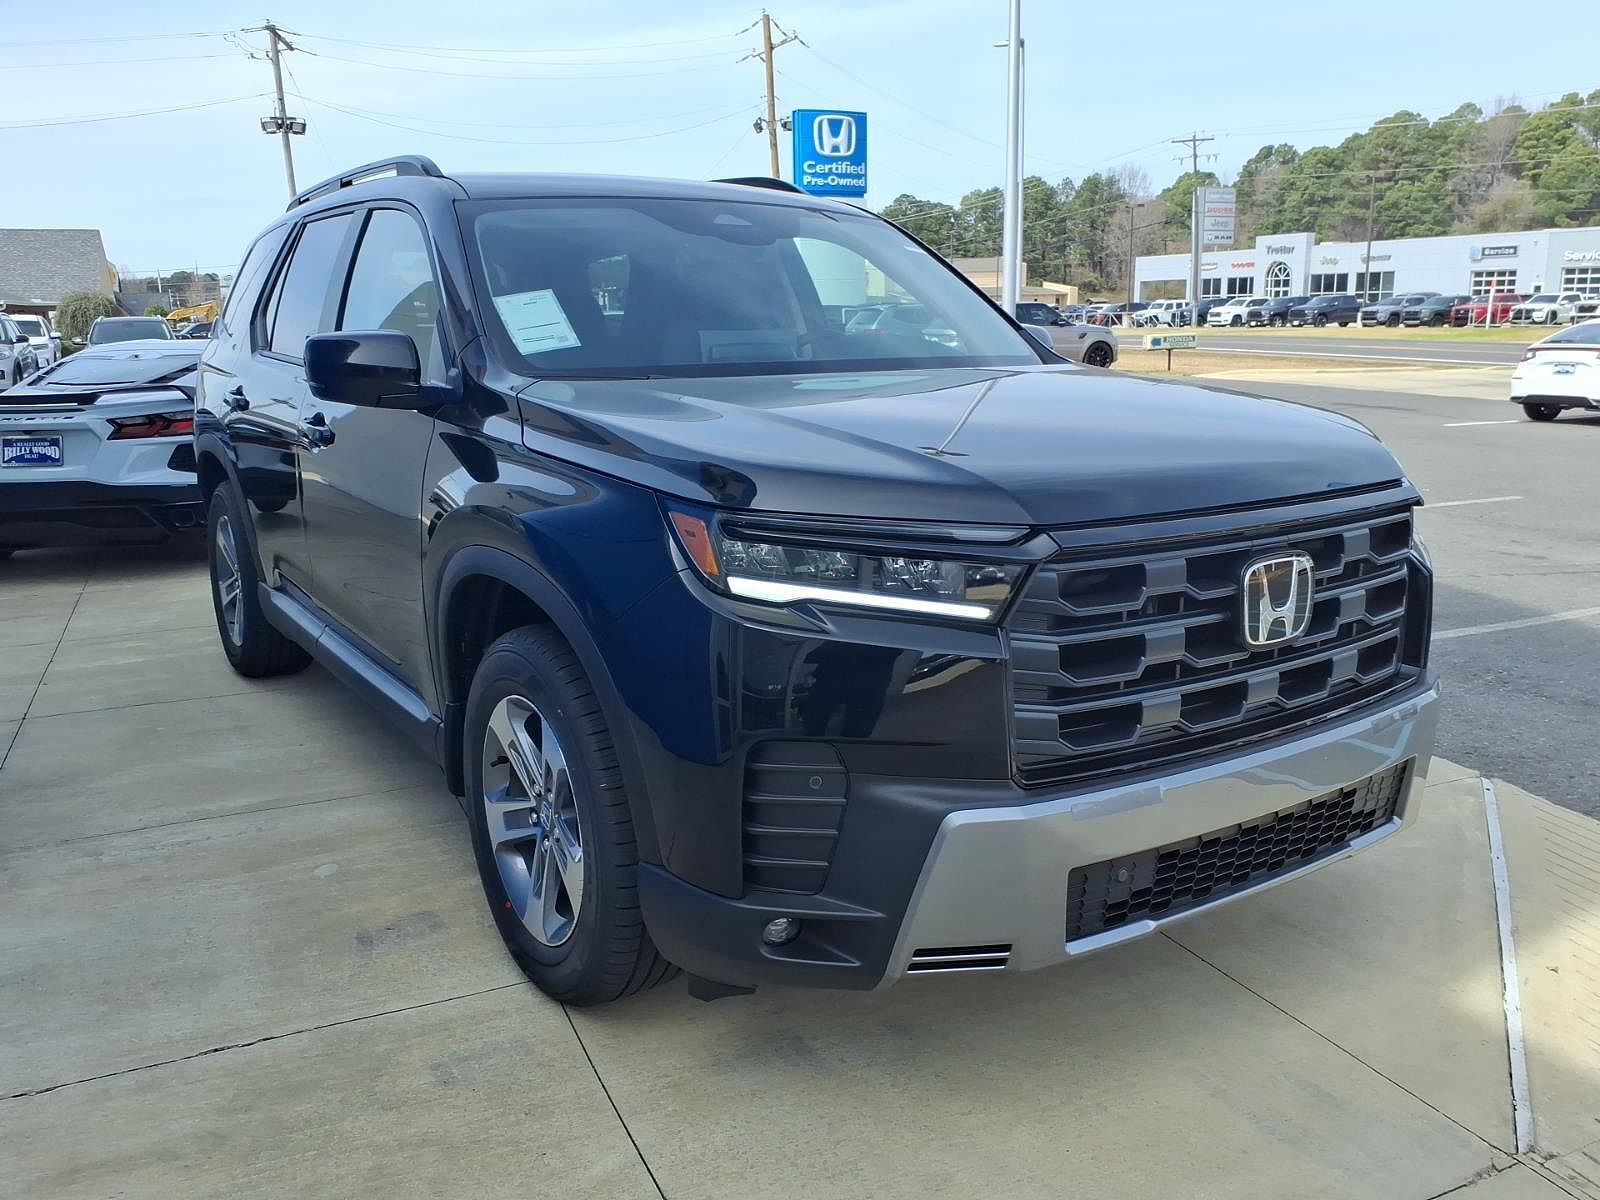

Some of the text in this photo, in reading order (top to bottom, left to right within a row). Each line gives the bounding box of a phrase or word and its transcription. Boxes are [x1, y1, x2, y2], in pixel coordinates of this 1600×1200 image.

[803, 161, 865, 174] Certified
[803, 176, 865, 187] Pre-Owned
[4, 446, 60, 462] BILLY WOOD
